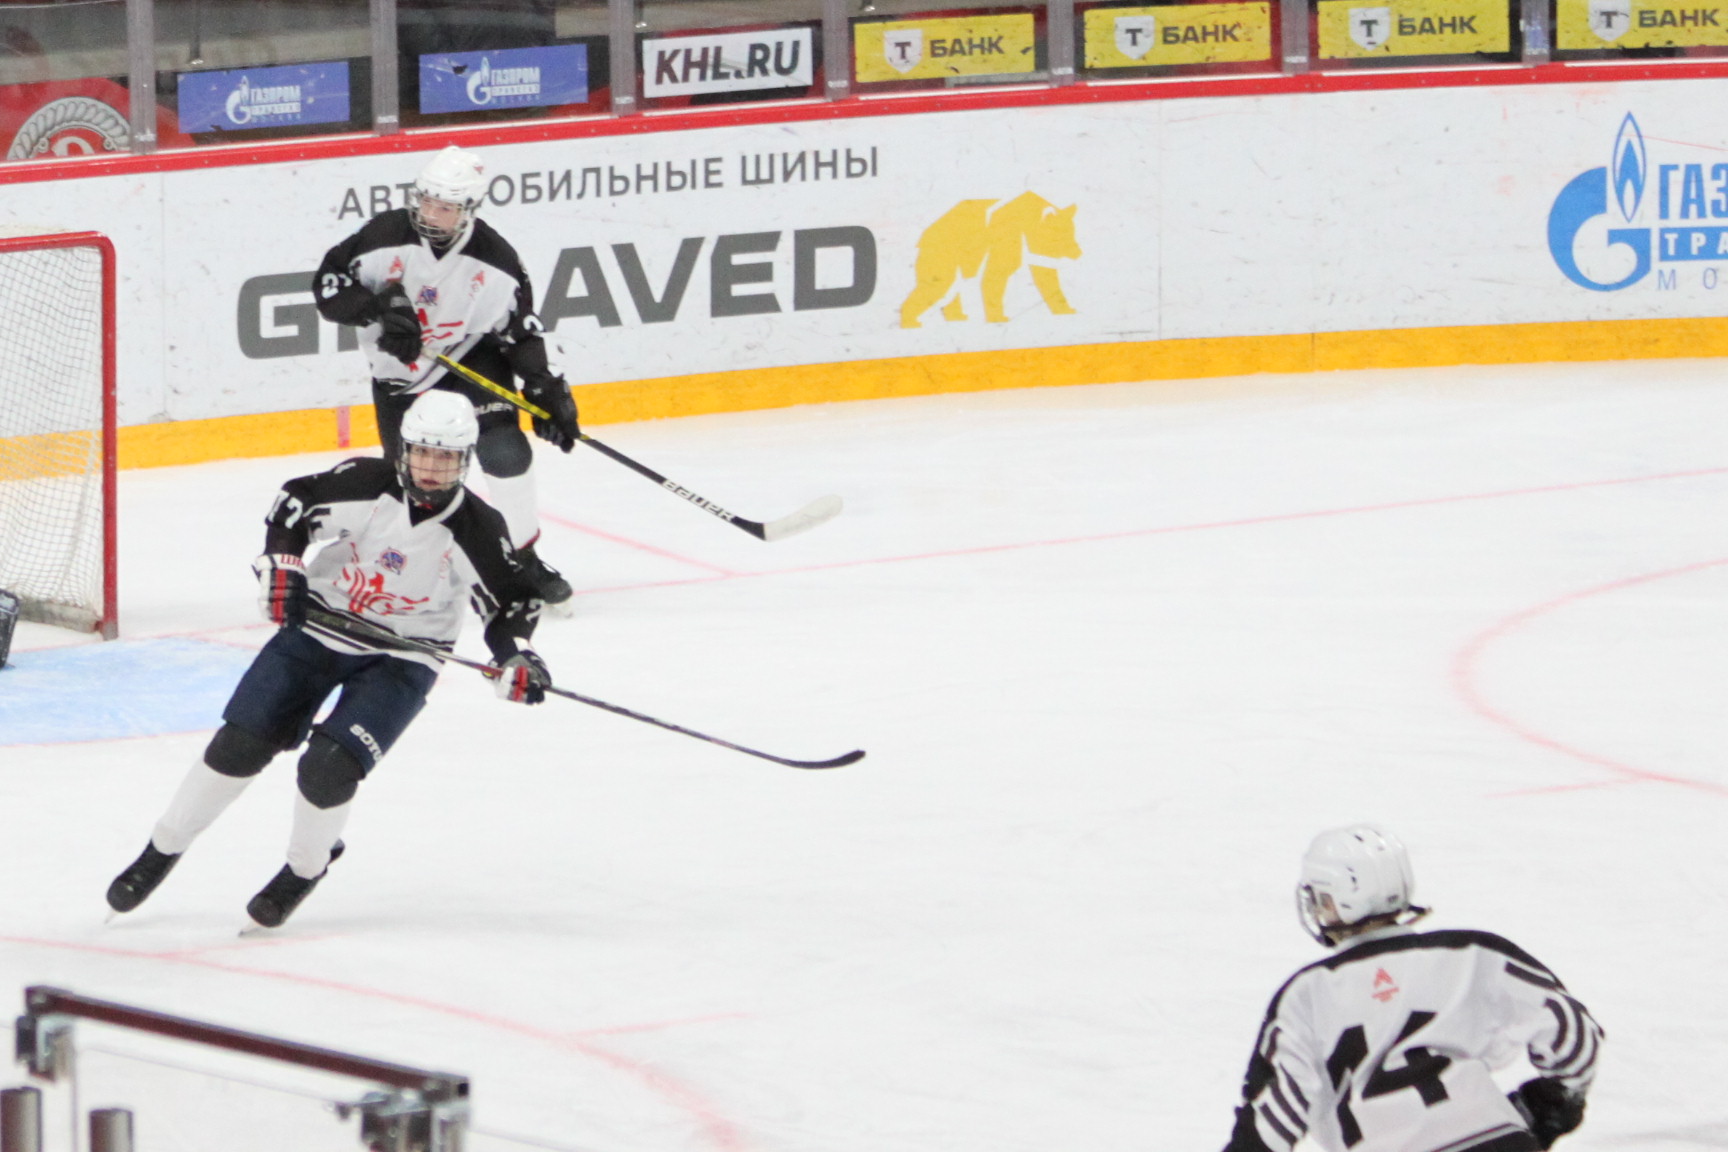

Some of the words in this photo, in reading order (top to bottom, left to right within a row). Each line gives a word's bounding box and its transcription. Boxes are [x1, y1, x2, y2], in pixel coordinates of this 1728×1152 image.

[1360, 18, 1379, 38] Т
[1397, 15, 1478, 38] БАНК
[1599, 9, 1619, 29] Т
[1638, 7, 1721, 29] БАНК
[894, 40, 912, 61] Т
[929, 35, 1006, 59] БАНК
[1124, 27, 1144, 48] Т
[1161, 21, 1241, 46] БАНК
[654, 39, 801, 86] KHL.RU
[338, 155, 724, 221] АВТОБИЛЬНЫЕ
[739, 145, 879, 188] ШИНЫ
[1658, 162, 1728, 221] ГАЗ
[1663, 231, 1728, 256] ТРА
[237, 225, 877, 360] GAVED
[1657, 267, 1718, 291] МО
[1325, 1010, 1452, 1150] 14
